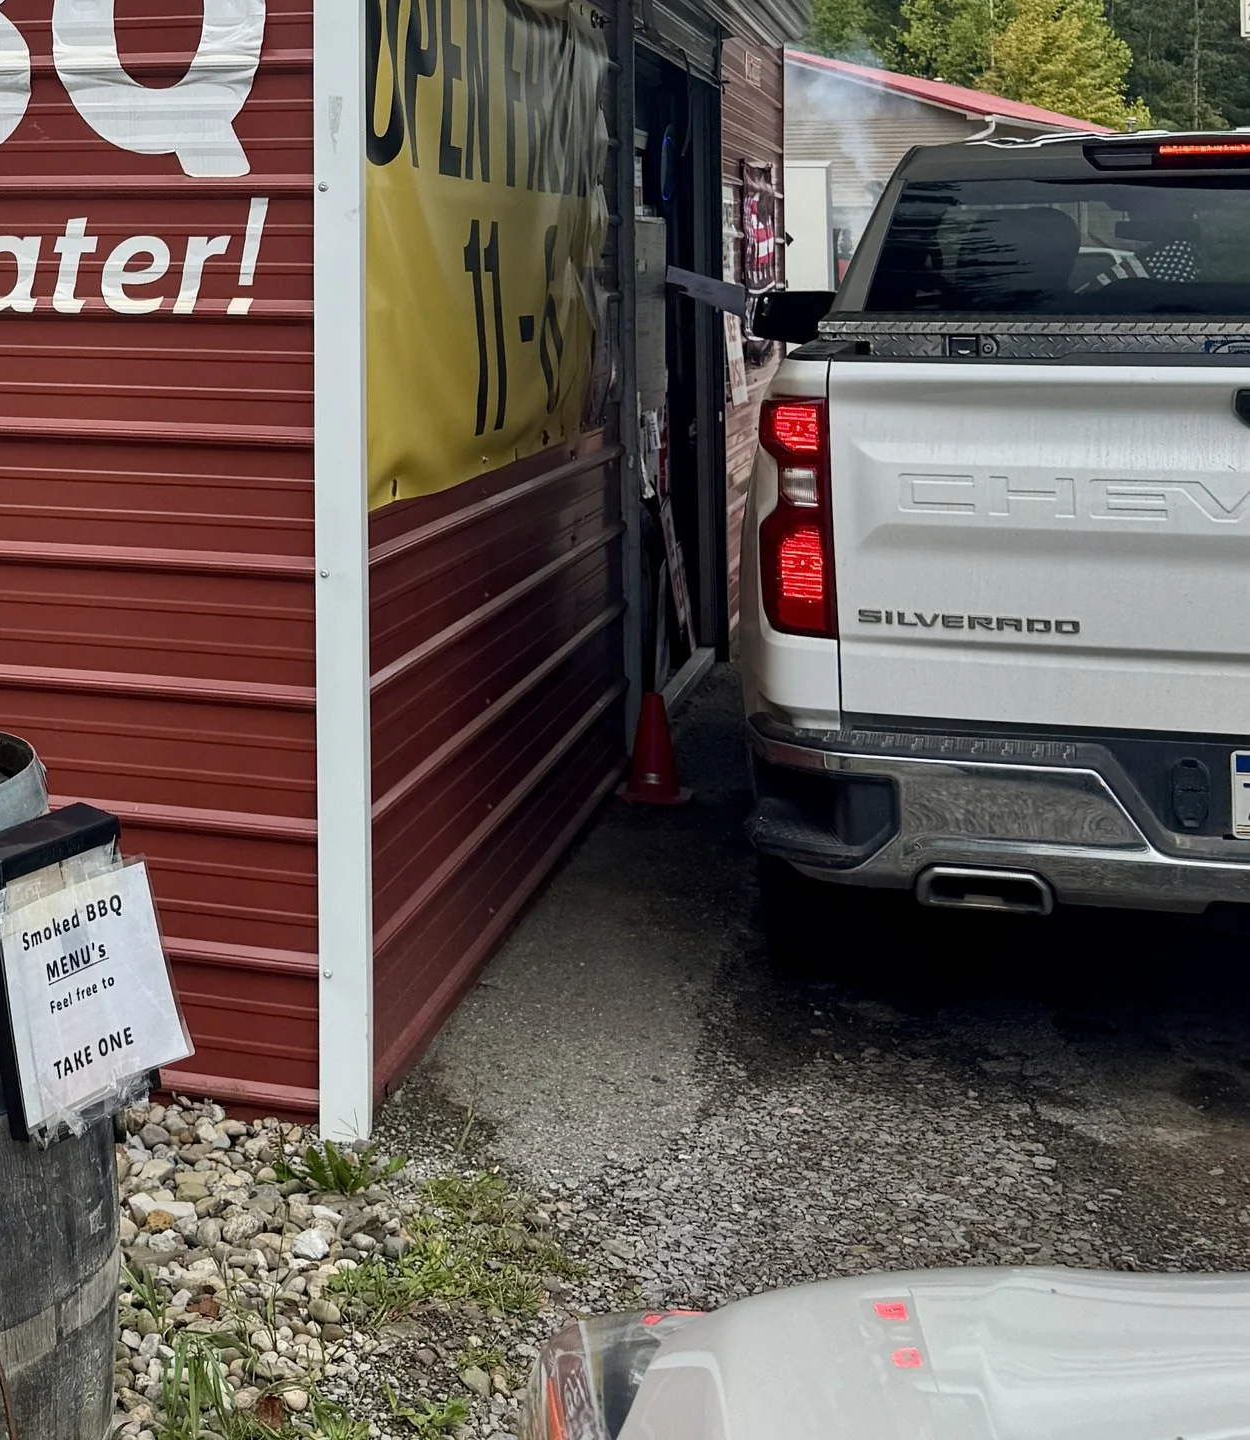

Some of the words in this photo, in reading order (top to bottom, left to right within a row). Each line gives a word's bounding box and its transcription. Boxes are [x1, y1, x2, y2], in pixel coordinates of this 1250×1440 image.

[897, 472, 1250, 524] CHEV
[858, 608, 1080, 635] SILVERADO
[21, 909, 81, 952] Smoked
[85, 894, 123, 923] BBQ
[46, 942, 107, 982] MENU's
[49, 991, 73, 1015] Feel
[76, 983, 98, 1002] free
[101, 976, 116, 990] to
[53, 1045, 94, 1080] TAKE
[98, 1026, 135, 1057] ONE
